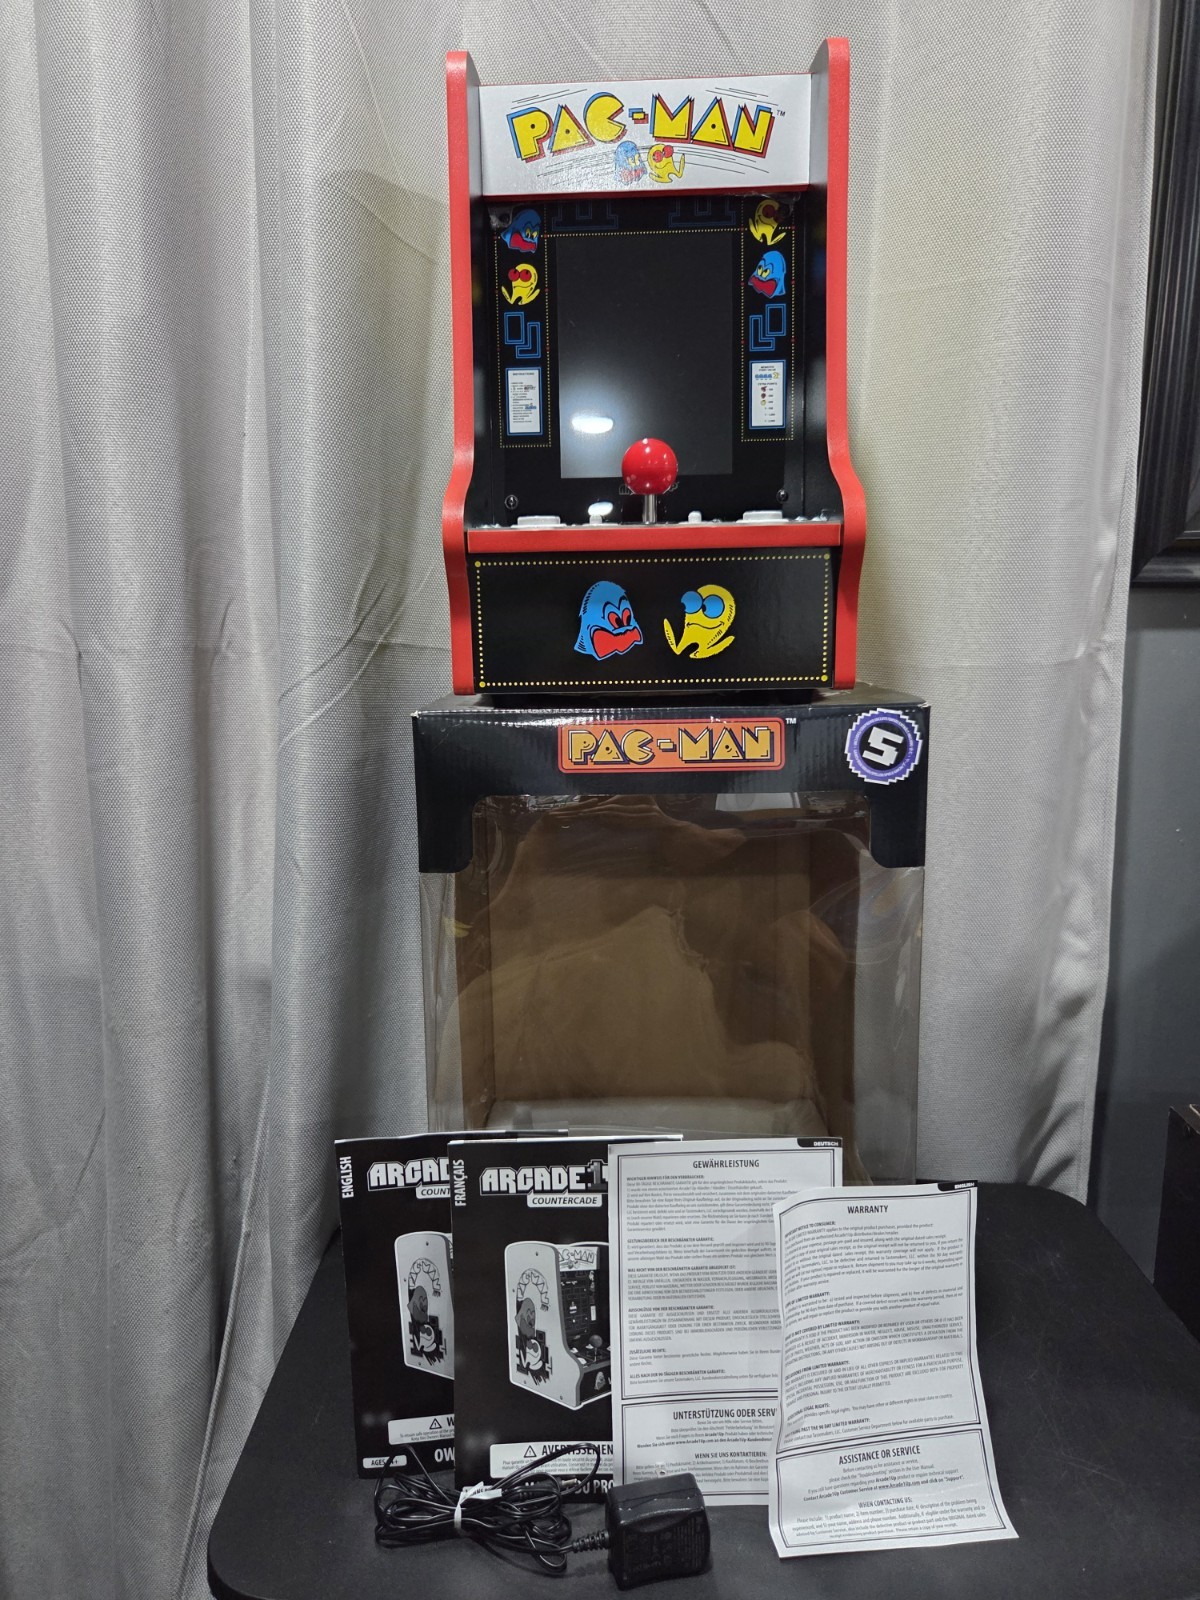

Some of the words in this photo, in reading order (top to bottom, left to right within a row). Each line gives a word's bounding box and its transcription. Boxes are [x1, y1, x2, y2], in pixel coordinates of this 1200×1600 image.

[507, 92, 775, 163] PAC-MAN
[568, 726, 774, 766] PAC-MAN
[692, 1158, 760, 1168] GEWÄHRLEISTUNG
[340, 1156, 354, 1199] ENGLISH
[453, 1159, 468, 1207] FRANÇAIS
[532, 1196, 598, 1205] COUNTERCADE
[847, 1205, 888, 1214] WARRANTY
[672, 1408, 734, 1420] UNTERSTÜTZUNG
[736, 1409, 756, 1418] ODER
[758, 1408, 778, 1417] SERV
[838, 1450, 880, 1465] ASSISTANCE
[881, 1448, 892, 1458] OR
[892, 1445, 920, 1458] SERVICE
